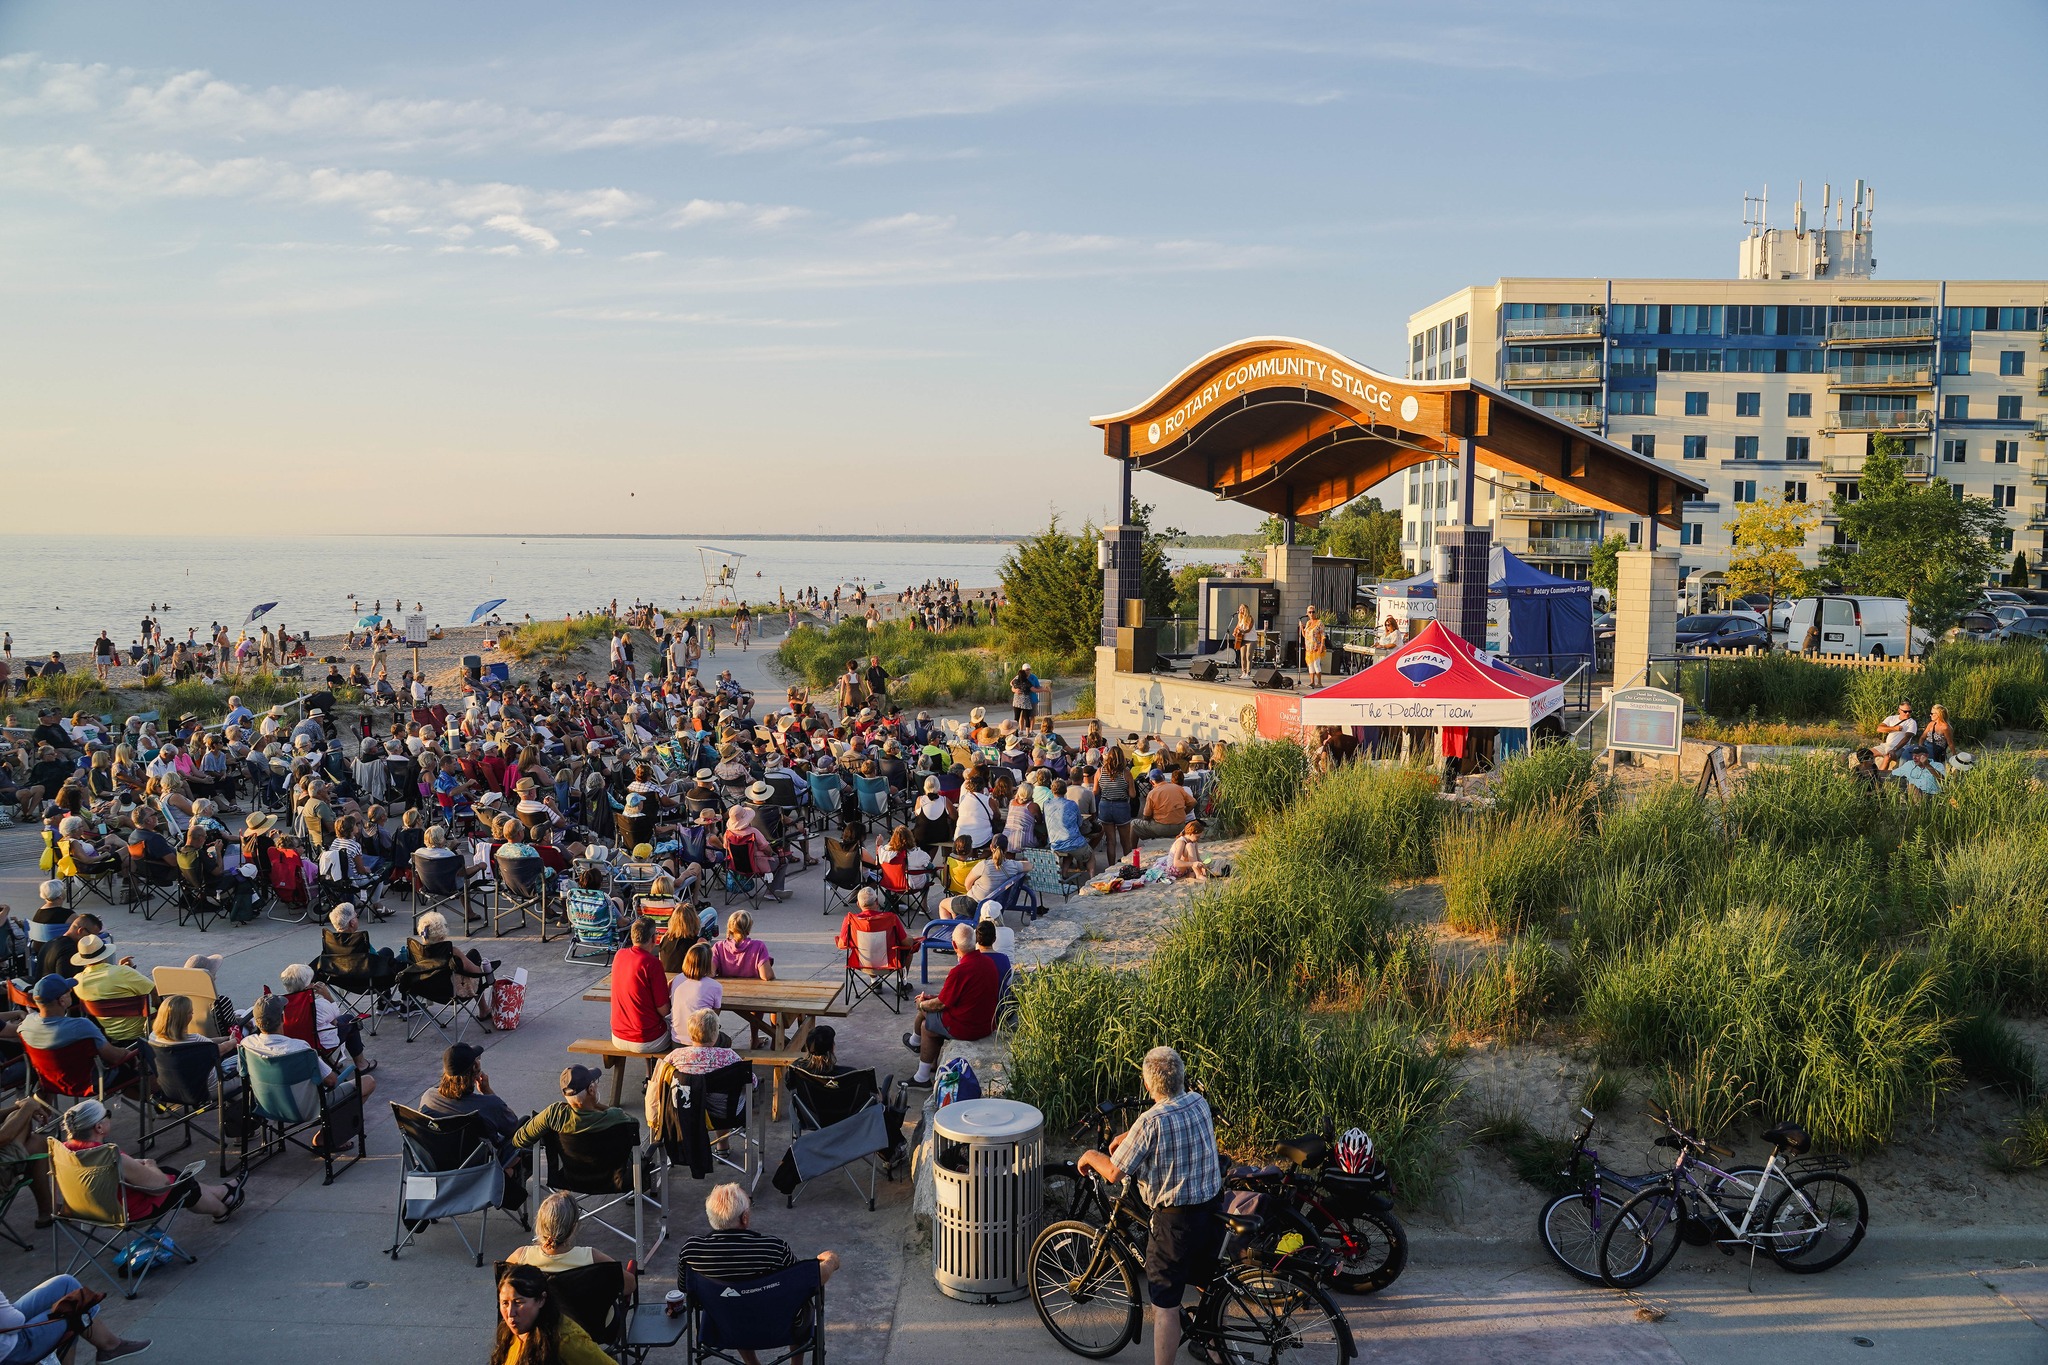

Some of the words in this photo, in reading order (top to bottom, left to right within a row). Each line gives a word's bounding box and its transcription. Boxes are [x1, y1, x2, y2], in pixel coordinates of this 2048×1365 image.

[1165, 380, 1223, 435] ROTARY
[1225, 357, 1328, 391] COMMUNITY
[1331, 368, 1393, 412] STAGE
[1533, 587, 1549, 595] Rotary
[1550, 586, 1576, 594] Community
[1388, 599, 1419, 611] THANK
[1404, 654, 1446, 665] RE/MAX
[1383, 703, 1434, 719] Pedlar
[1629, 702, 1663, 710] Stagehands
[763, 1281, 780, 1290] TRAIL
